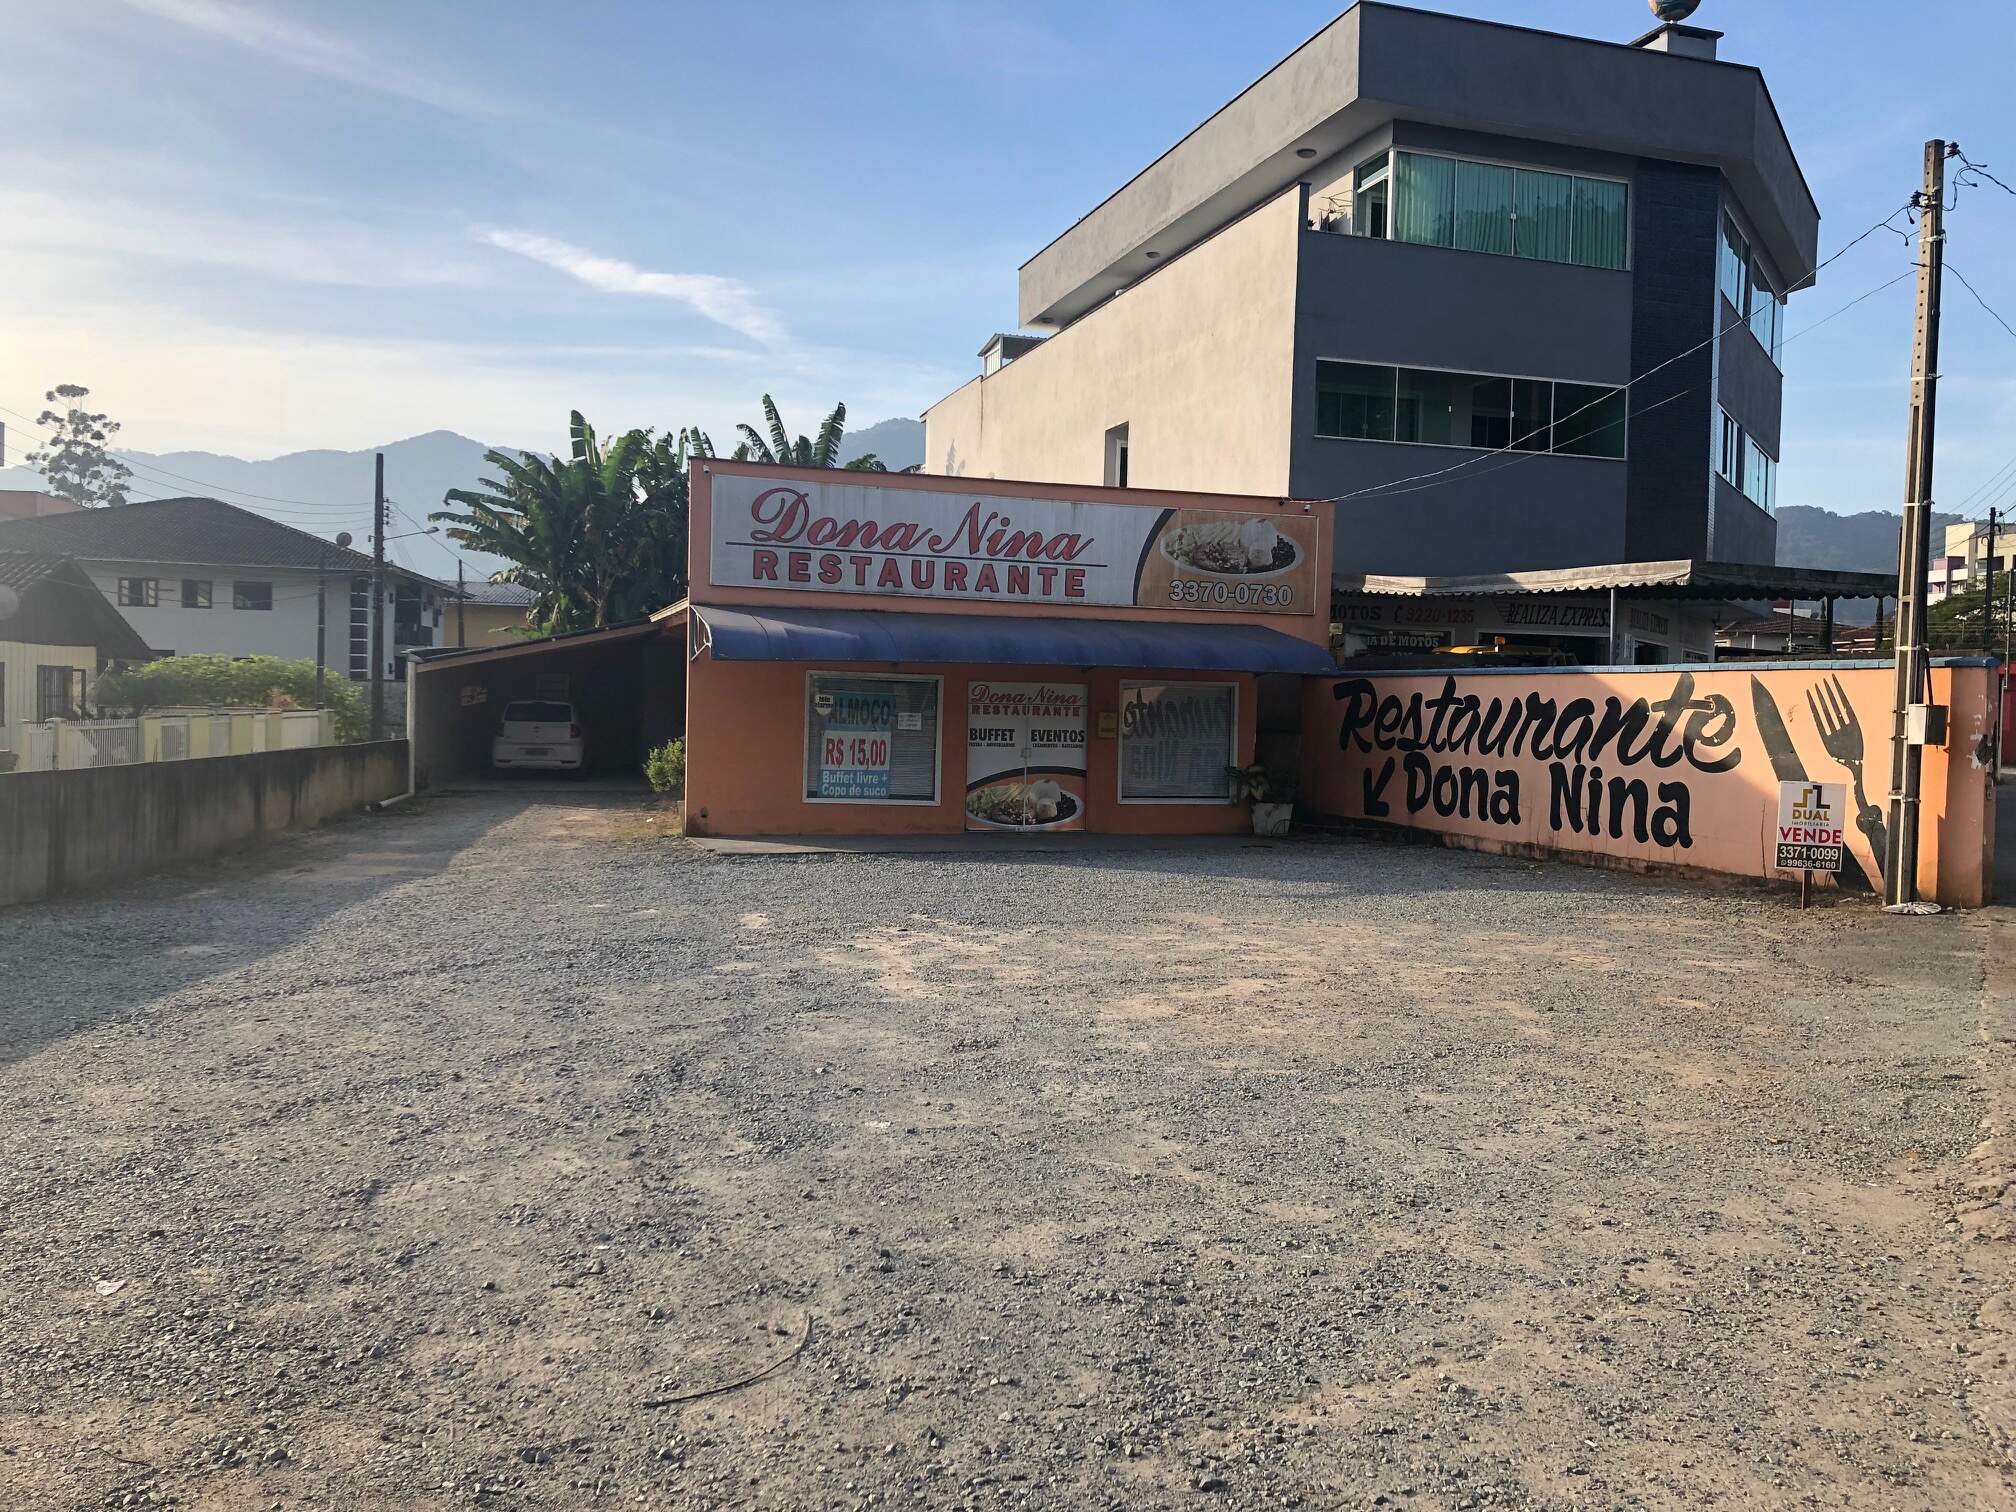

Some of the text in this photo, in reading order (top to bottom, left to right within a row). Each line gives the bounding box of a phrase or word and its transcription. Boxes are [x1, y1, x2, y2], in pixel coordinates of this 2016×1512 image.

[751, 487, 1095, 561] Dona Nina
[753, 549, 1085, 598] RESTAURANTE
[1169, 579, 1293, 607] 3370-0730
[1407, 608, 1474, 624] 9220-1235
[1399, 637, 1439, 648] MOTOS
[971, 684, 1082, 705] Dona Nina
[828, 697, 891, 731] ALMOÇO
[971, 704, 1081, 717] RESTAURANTE
[1333, 672, 1742, 774] Restaurante
[969, 728, 1016, 742] BUFFET
[1031, 729, 1086, 743] EVENTOS
[825, 738, 887, 769] R$ 15,00
[822, 771, 855, 784] Buffet
[857, 772, 880, 785] livre
[850, 784, 862, 797] de
[863, 787, 887, 797] suco
[1403, 752, 1693, 849] Dona Nina
[1792, 809, 1830, 822] DUAL
[1780, 826, 1842, 844] VENDE
[1779, 846, 1839, 861] 3371-0099
